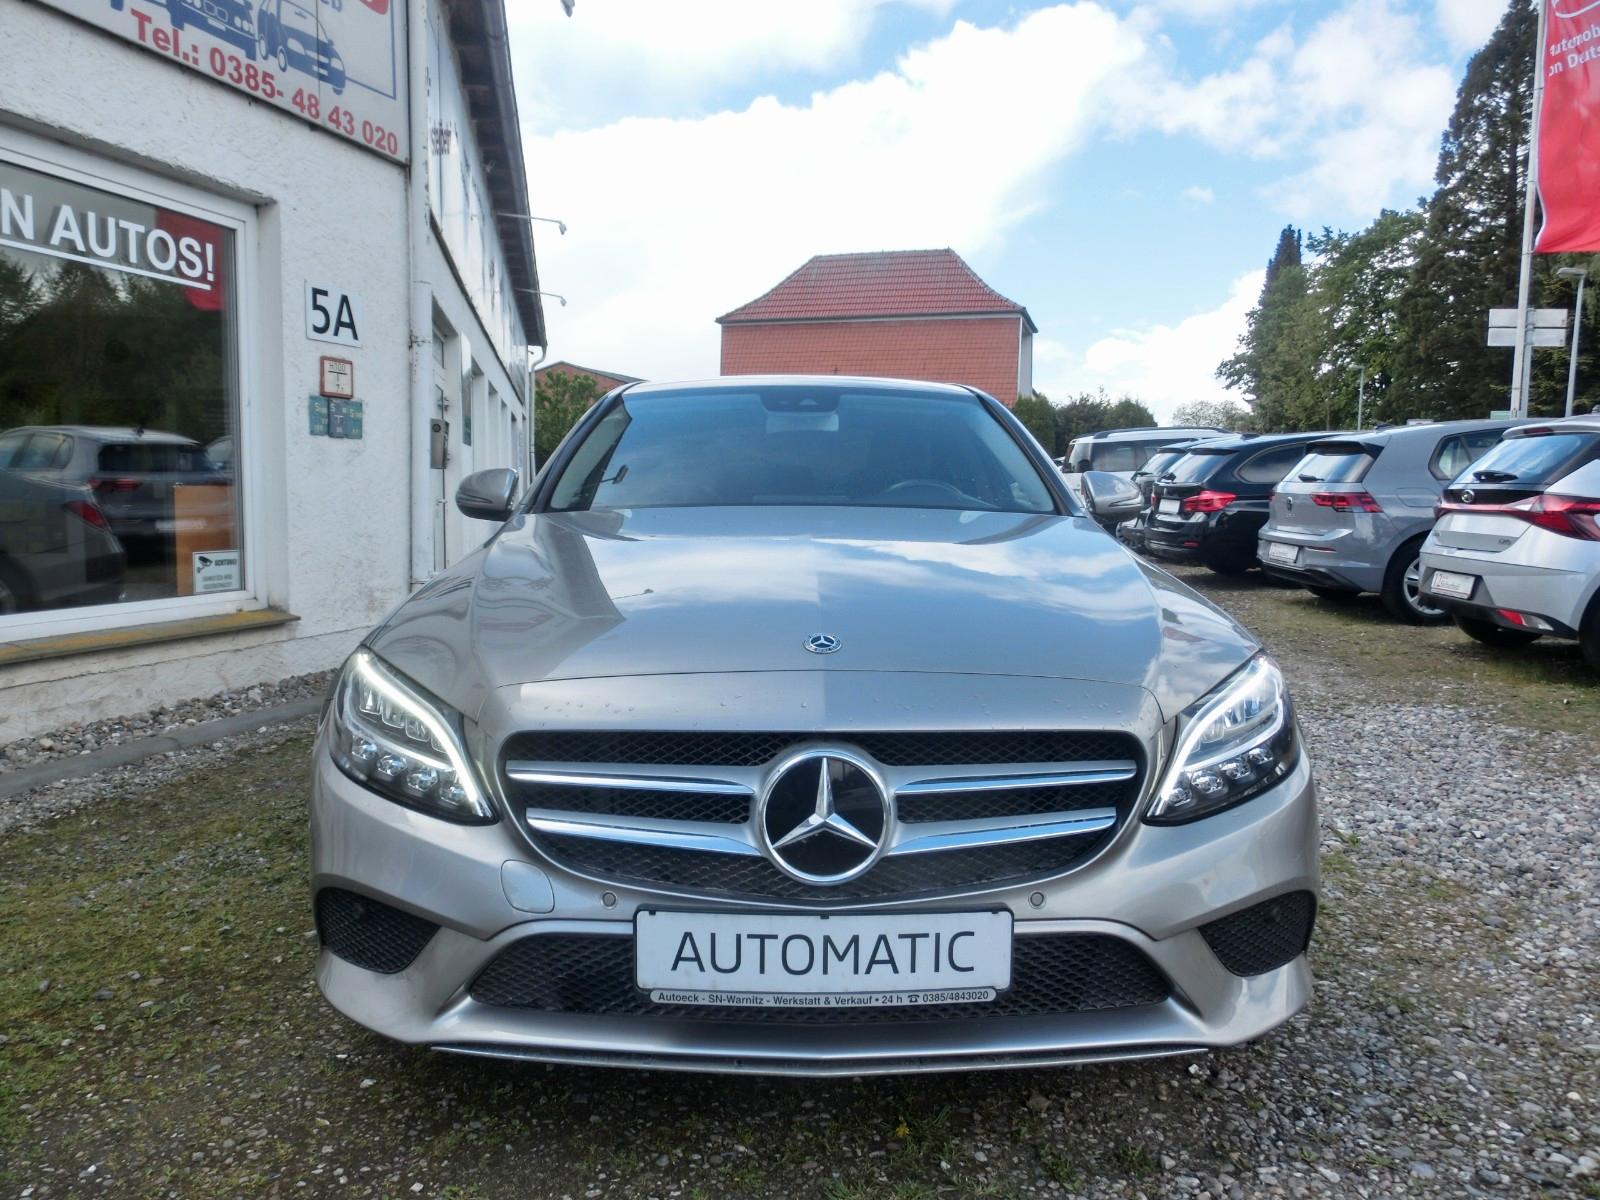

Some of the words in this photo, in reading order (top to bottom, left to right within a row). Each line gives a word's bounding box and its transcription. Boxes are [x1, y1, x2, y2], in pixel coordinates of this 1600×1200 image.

[130, 8, 199, 66] Tel.:
[209, 47, 284, 99] 0385-
[291, 88, 320, 120] 48
[328, 105, 355, 136] 43
[362, 120, 398, 155] 020
[50, 204, 215, 282] AUTOS!
[311, 286, 359, 341] 5A
[671, 931, 975, 975] AUTOMATIC
[658, 992, 699, 1003] Autoeck
[708, 994, 764, 1005] SN-Warnitz
[773, 995, 820, 1005] Werkstatt
[824, 995, 831, 1005] &
[834, 994, 872, 1005] Verkauf
[881, 993, 893, 1004] 24
[896, 993, 903, 1004] h
[922, 990, 989, 1003] 0385/4843020
